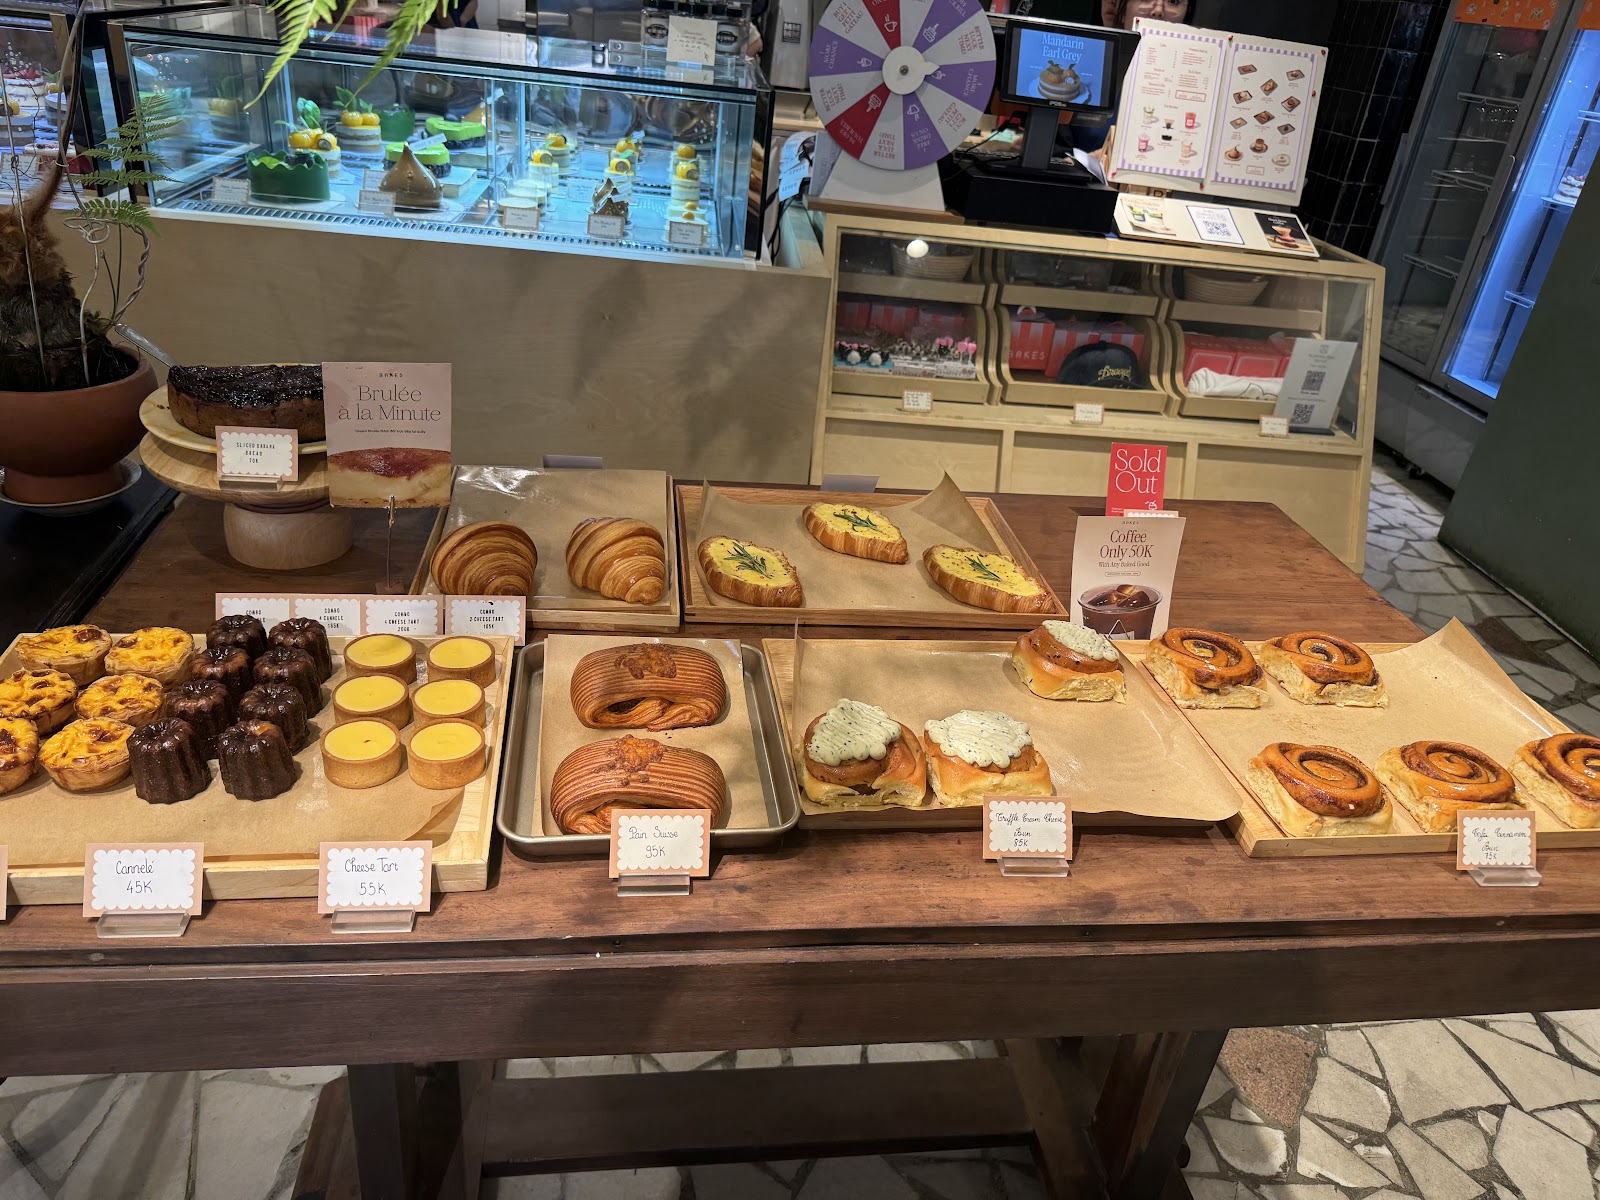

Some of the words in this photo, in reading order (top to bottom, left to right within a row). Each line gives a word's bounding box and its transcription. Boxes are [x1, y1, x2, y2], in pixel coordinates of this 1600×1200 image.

[833, 6, 843, 18] BUY
[964, 34, 973, 52] NEXT
[969, 31, 978, 49] LUCK
[974, 25, 984, 50] BETTER
[1042, 34, 1084, 50] Mandarin
[828, 41, 838, 69] CHANCE
[1042, 46, 1060, 58] Earl
[1062, 47, 1082, 63] Grey
[820, 88, 831, 112] BETTER
[878, 138, 894, 147] NEXT
[874, 150, 896, 160] BETTER
[1008, 351, 1046, 360] BAKES
[357, 384, 422, 402] Brulée
[338, 405, 351, 420] à
[356, 404, 373, 420] la
[379, 404, 441, 421] Minute
[1114, 448, 1161, 472] Sold
[1116, 470, 1158, 494] Out
[1110, 530, 1147, 543] Coffee
[1100, 544, 1127, 561] Only
[1128, 544, 1154, 558] 50K
[996, 812, 1020, 826] Truffle
[1022, 813, 1040, 822] Cream
[1044, 813, 1063, 822] Cheese
[628, 826, 647, 840] Pain
[653, 826, 678, 838] Suisse
[1014, 827, 1032, 836] Bun
[1494, 827, 1527, 838] Cinnamon
[1014, 838, 1028, 847] 85K
[1482, 842, 1498, 852] Bun
[646, 845, 666, 858] 95K
[116, 858, 154, 874] Cannelé
[344, 857, 376, 872] Cheese
[377, 857, 398, 872] Tart
[126, 880, 153, 894] 45K
[359, 882, 386, 896] 55K
